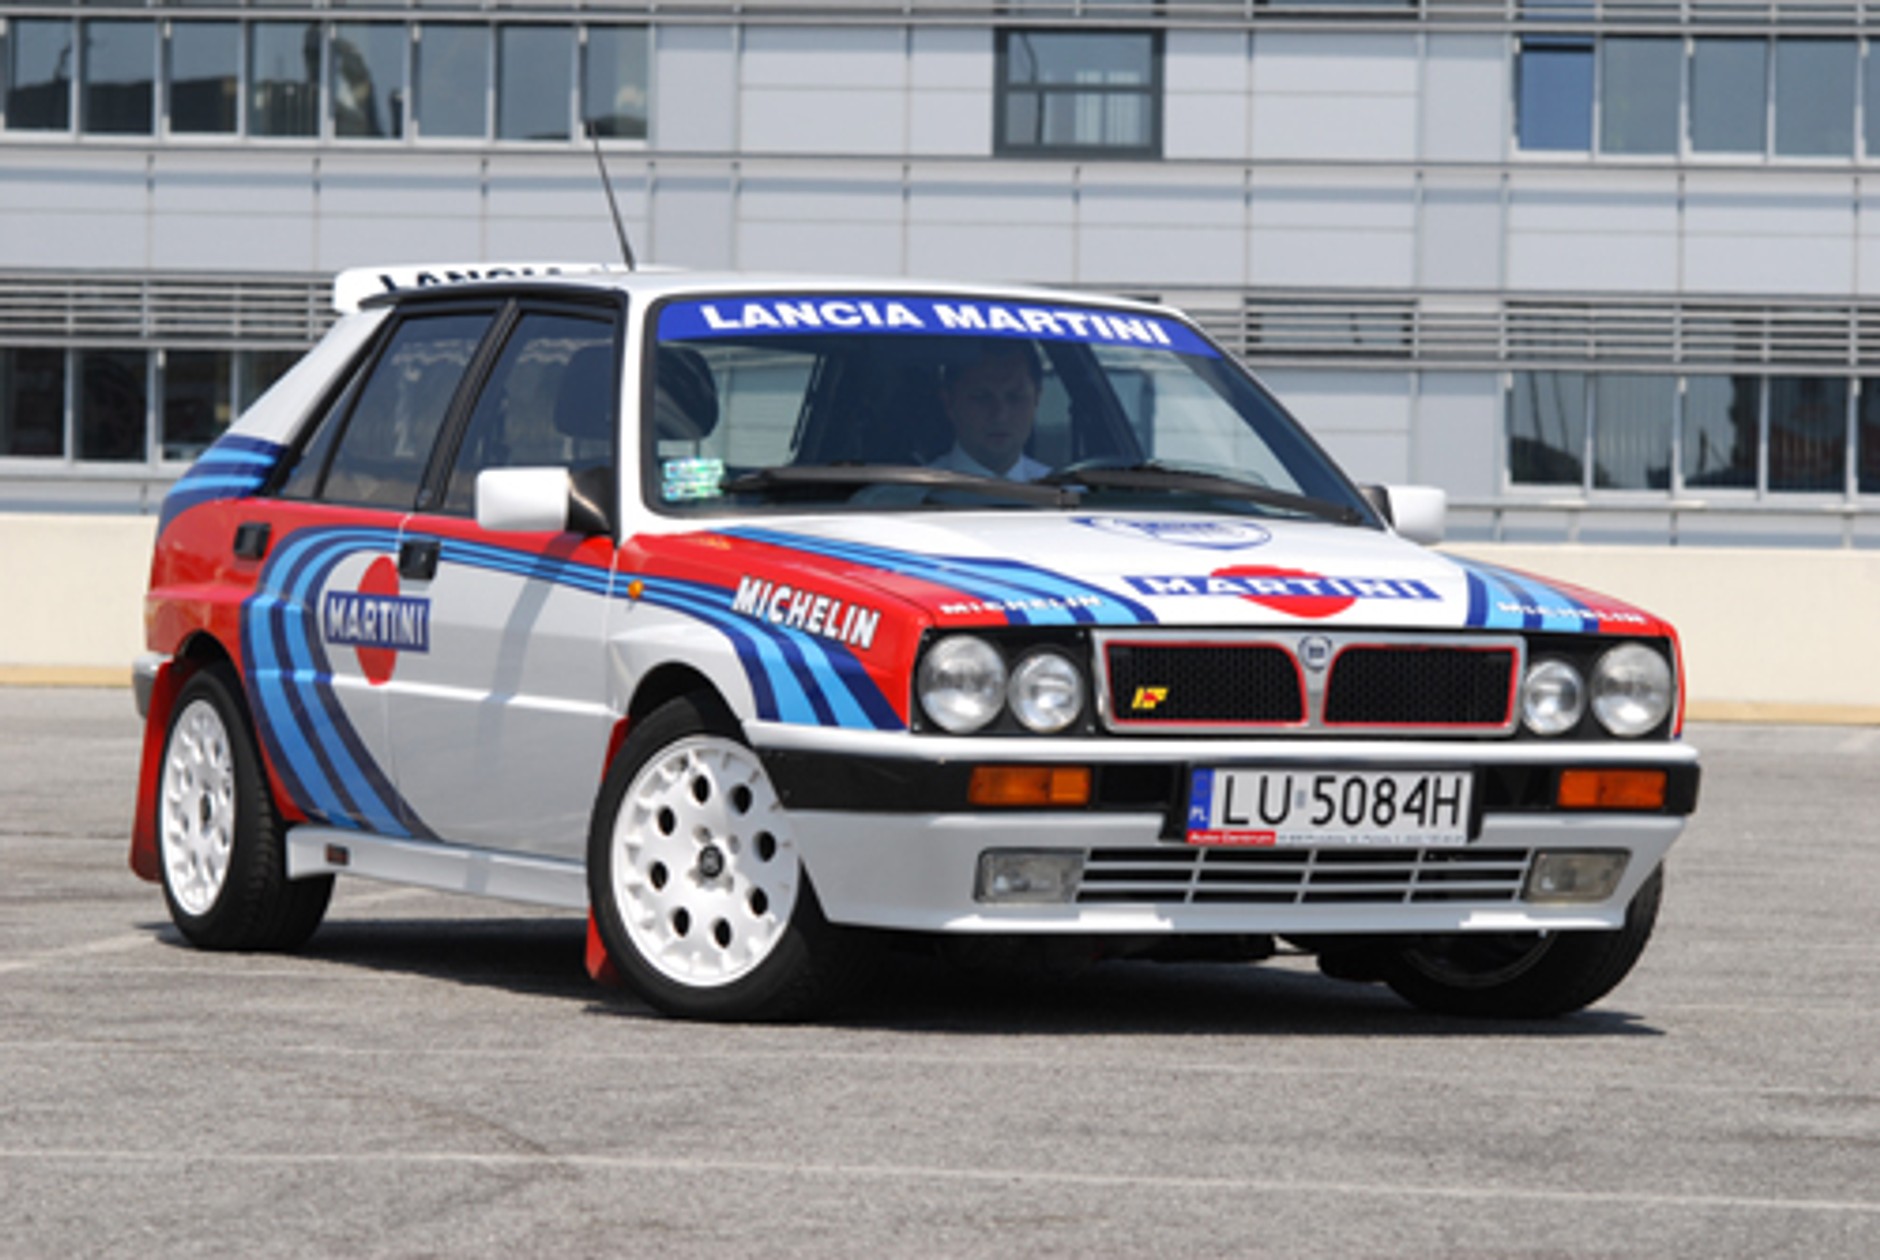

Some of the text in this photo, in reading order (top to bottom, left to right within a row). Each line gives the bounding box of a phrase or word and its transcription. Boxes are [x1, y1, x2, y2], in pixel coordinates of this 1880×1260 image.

[701, 302, 1171, 345] LANCIA MARTINI
[939, 595, 1101, 615] MICHELIN
[1143, 576, 1428, 598] MARTINI
[328, 597, 426, 646] MARTINI
[731, 575, 881, 650] MICHELIN
[1189, 806, 1210, 822] PL
[1222, 774, 1463, 828] LU 5084H
